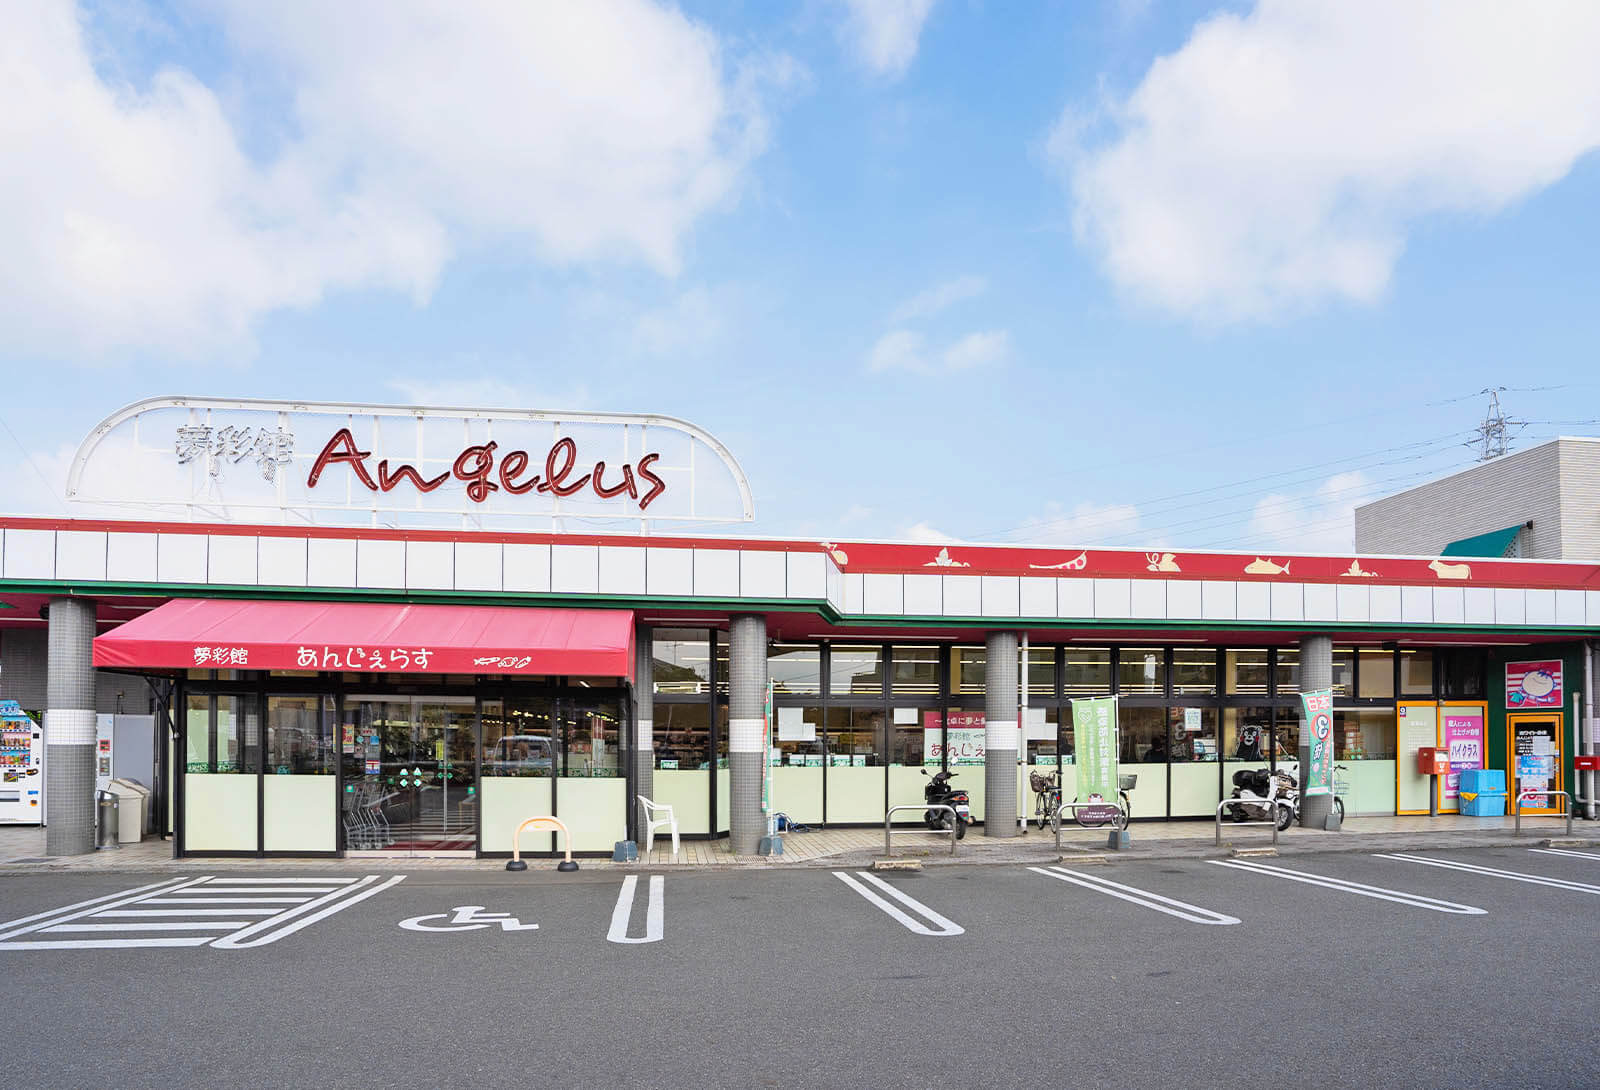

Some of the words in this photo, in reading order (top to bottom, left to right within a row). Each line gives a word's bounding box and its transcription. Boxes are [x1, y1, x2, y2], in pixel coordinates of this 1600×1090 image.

[307, 427, 666, 509] Angelus
[193, 647, 249, 666] 夢彩館
[1451, 743, 1479, 759] ハイクラス
